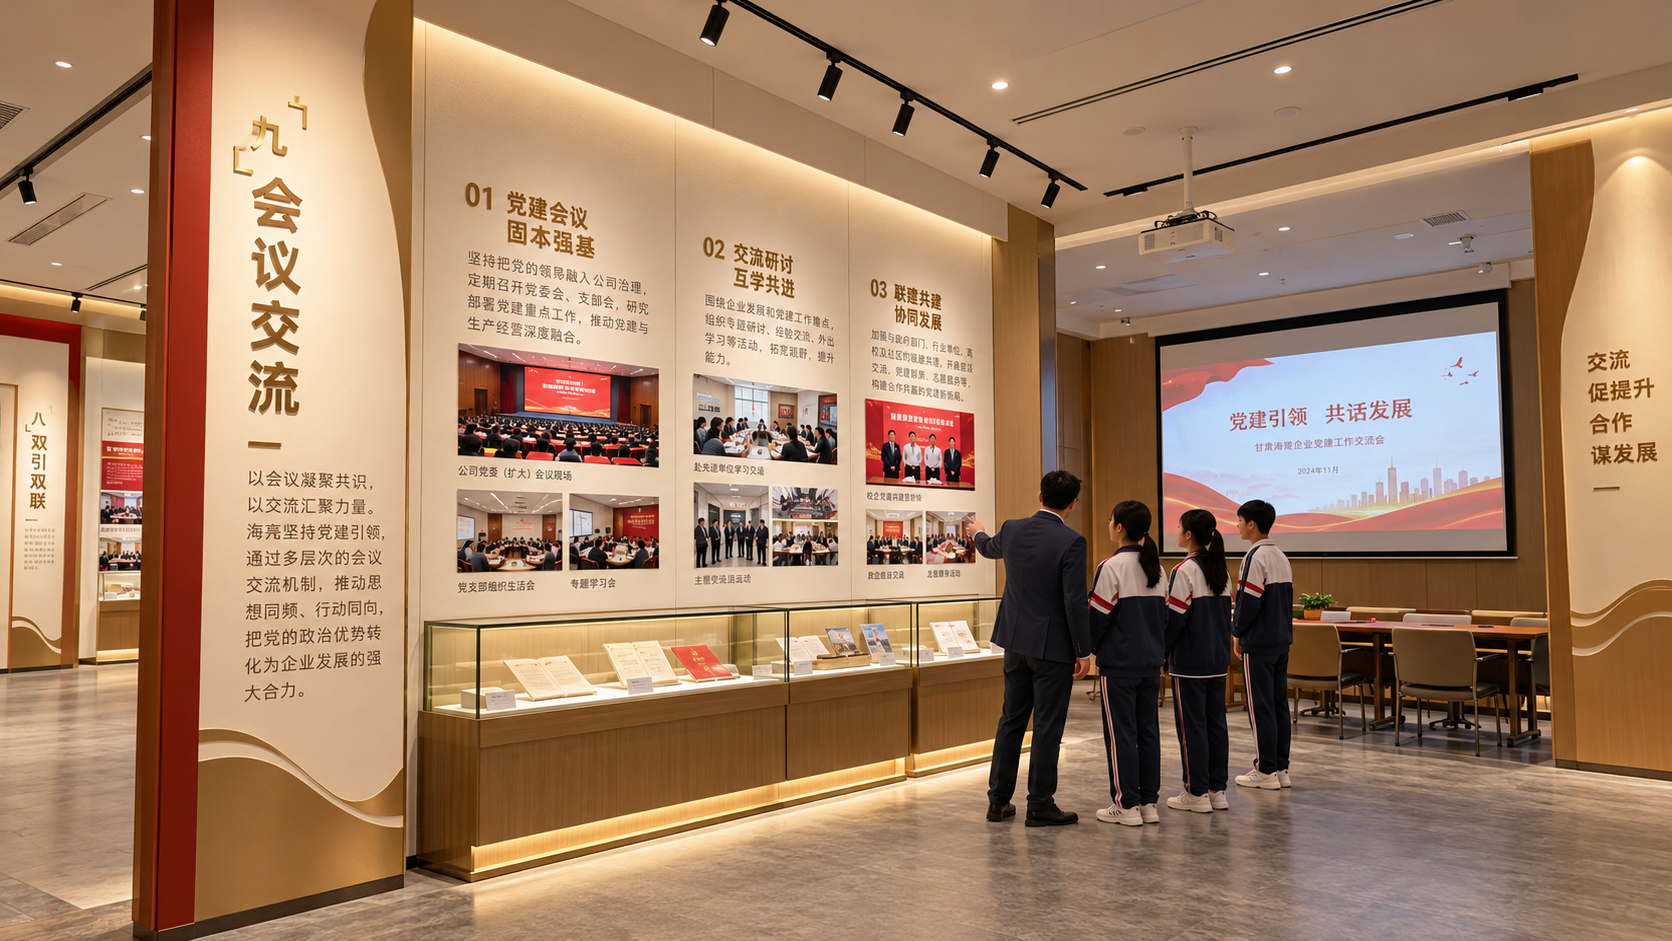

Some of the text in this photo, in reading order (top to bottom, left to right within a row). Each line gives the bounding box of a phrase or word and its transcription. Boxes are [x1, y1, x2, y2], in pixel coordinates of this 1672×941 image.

[465, 182, 589, 231] 01 党建会议
[507, 219, 595, 259] 固本强基
[703, 236, 794, 275] 02 交流研讨
[733, 267, 795, 299] 互学共进
[870, 278, 942, 311] 03 联建共建
[894, 304, 942, 332] 协同发展
[1587, 349, 1630, 373] 交流
[1588, 377, 1655, 403] 促提升
[1229, 398, 1413, 432] 党建引领 共话发展
[1589, 412, 1633, 435] 合作
[1591, 442, 1658, 465] 谋发展
[248, 470, 374, 490] 以会议凝聚共识，
[1297, 466, 1339, 475] 2024年11月
[247, 497, 374, 515] 以交流汇聚力量。
[246, 522, 386, 541] 海亮坚持党建引领，
[246, 549, 382, 567] 通过多层次的会议
[246, 575, 382, 594] 交流机制，推动思
[245, 599, 384, 620] 想同频、行动同向，
[245, 624, 382, 648] 把党的政治优势转
[244, 650, 382, 675] 化为企业发展的强
[244, 682, 304, 703] 大合力。
